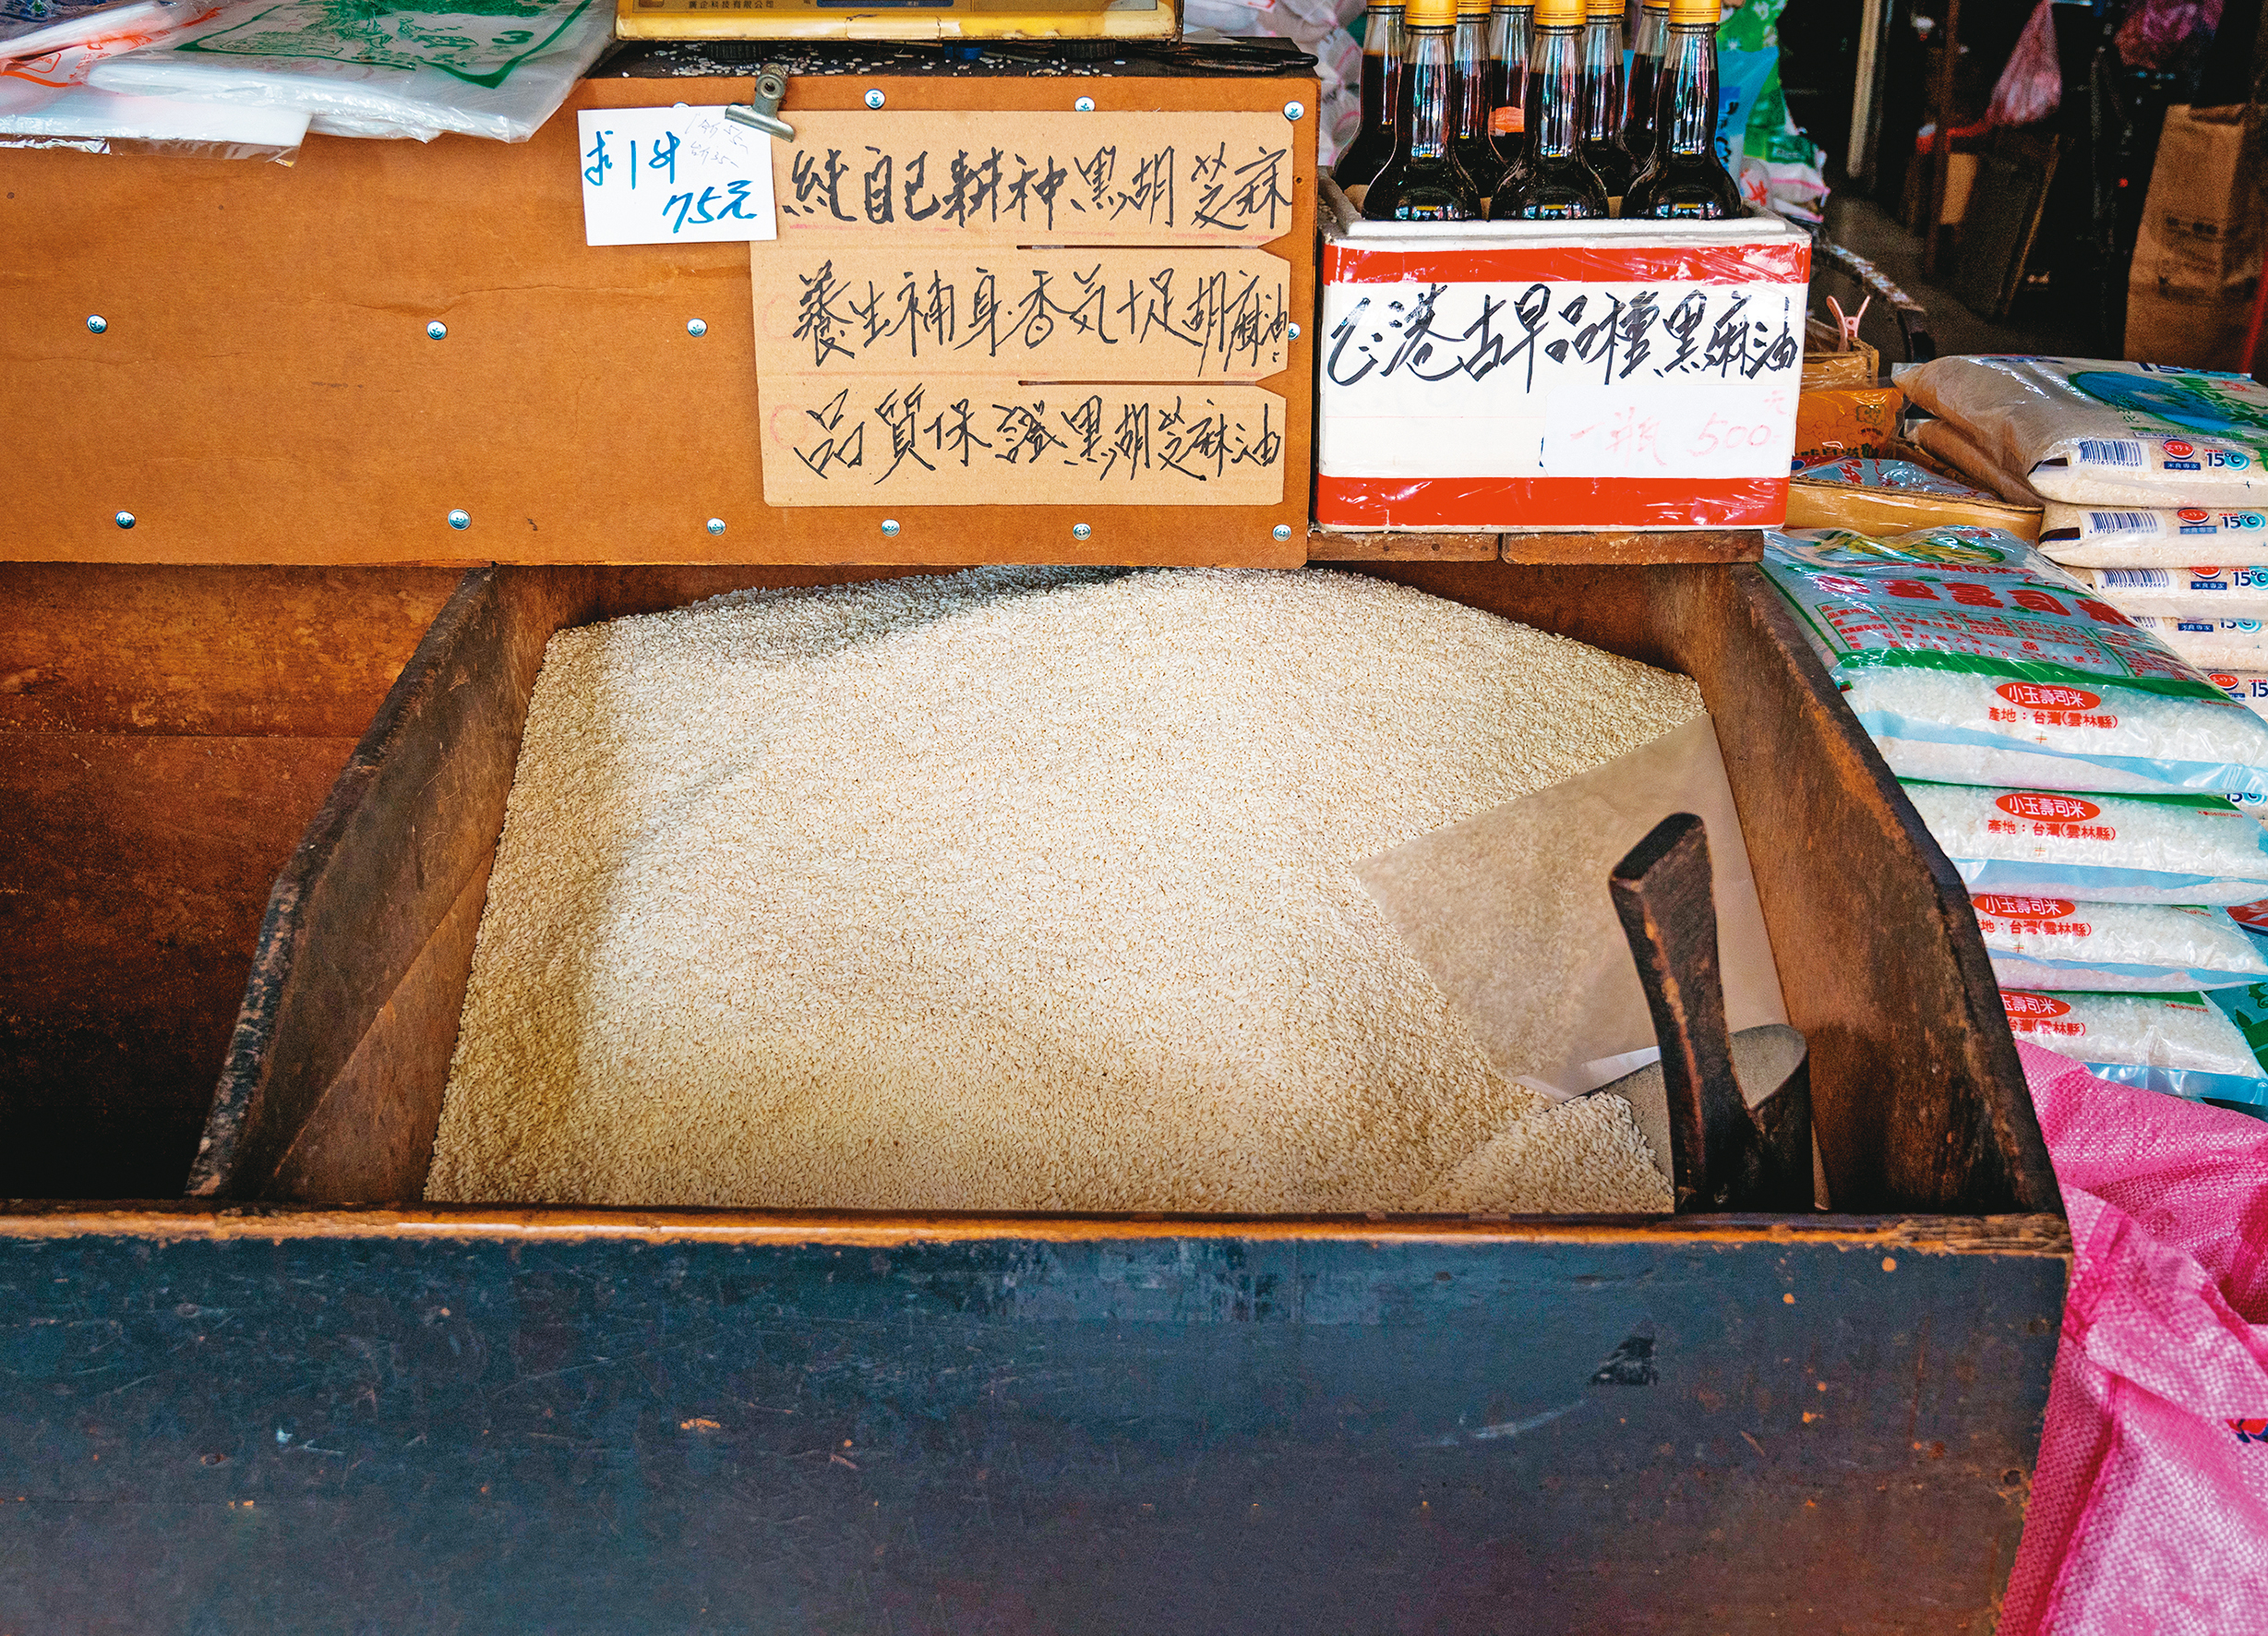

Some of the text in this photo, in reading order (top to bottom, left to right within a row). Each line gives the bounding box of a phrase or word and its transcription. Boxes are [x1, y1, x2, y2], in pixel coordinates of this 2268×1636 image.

[662, 180, 758, 234] 75元
[2009, 684, 2086, 708] 小玉壽司米
[2009, 795, 2086, 819] 小玉壽司米
[1986, 896, 2062, 916] 小玉壽司米
